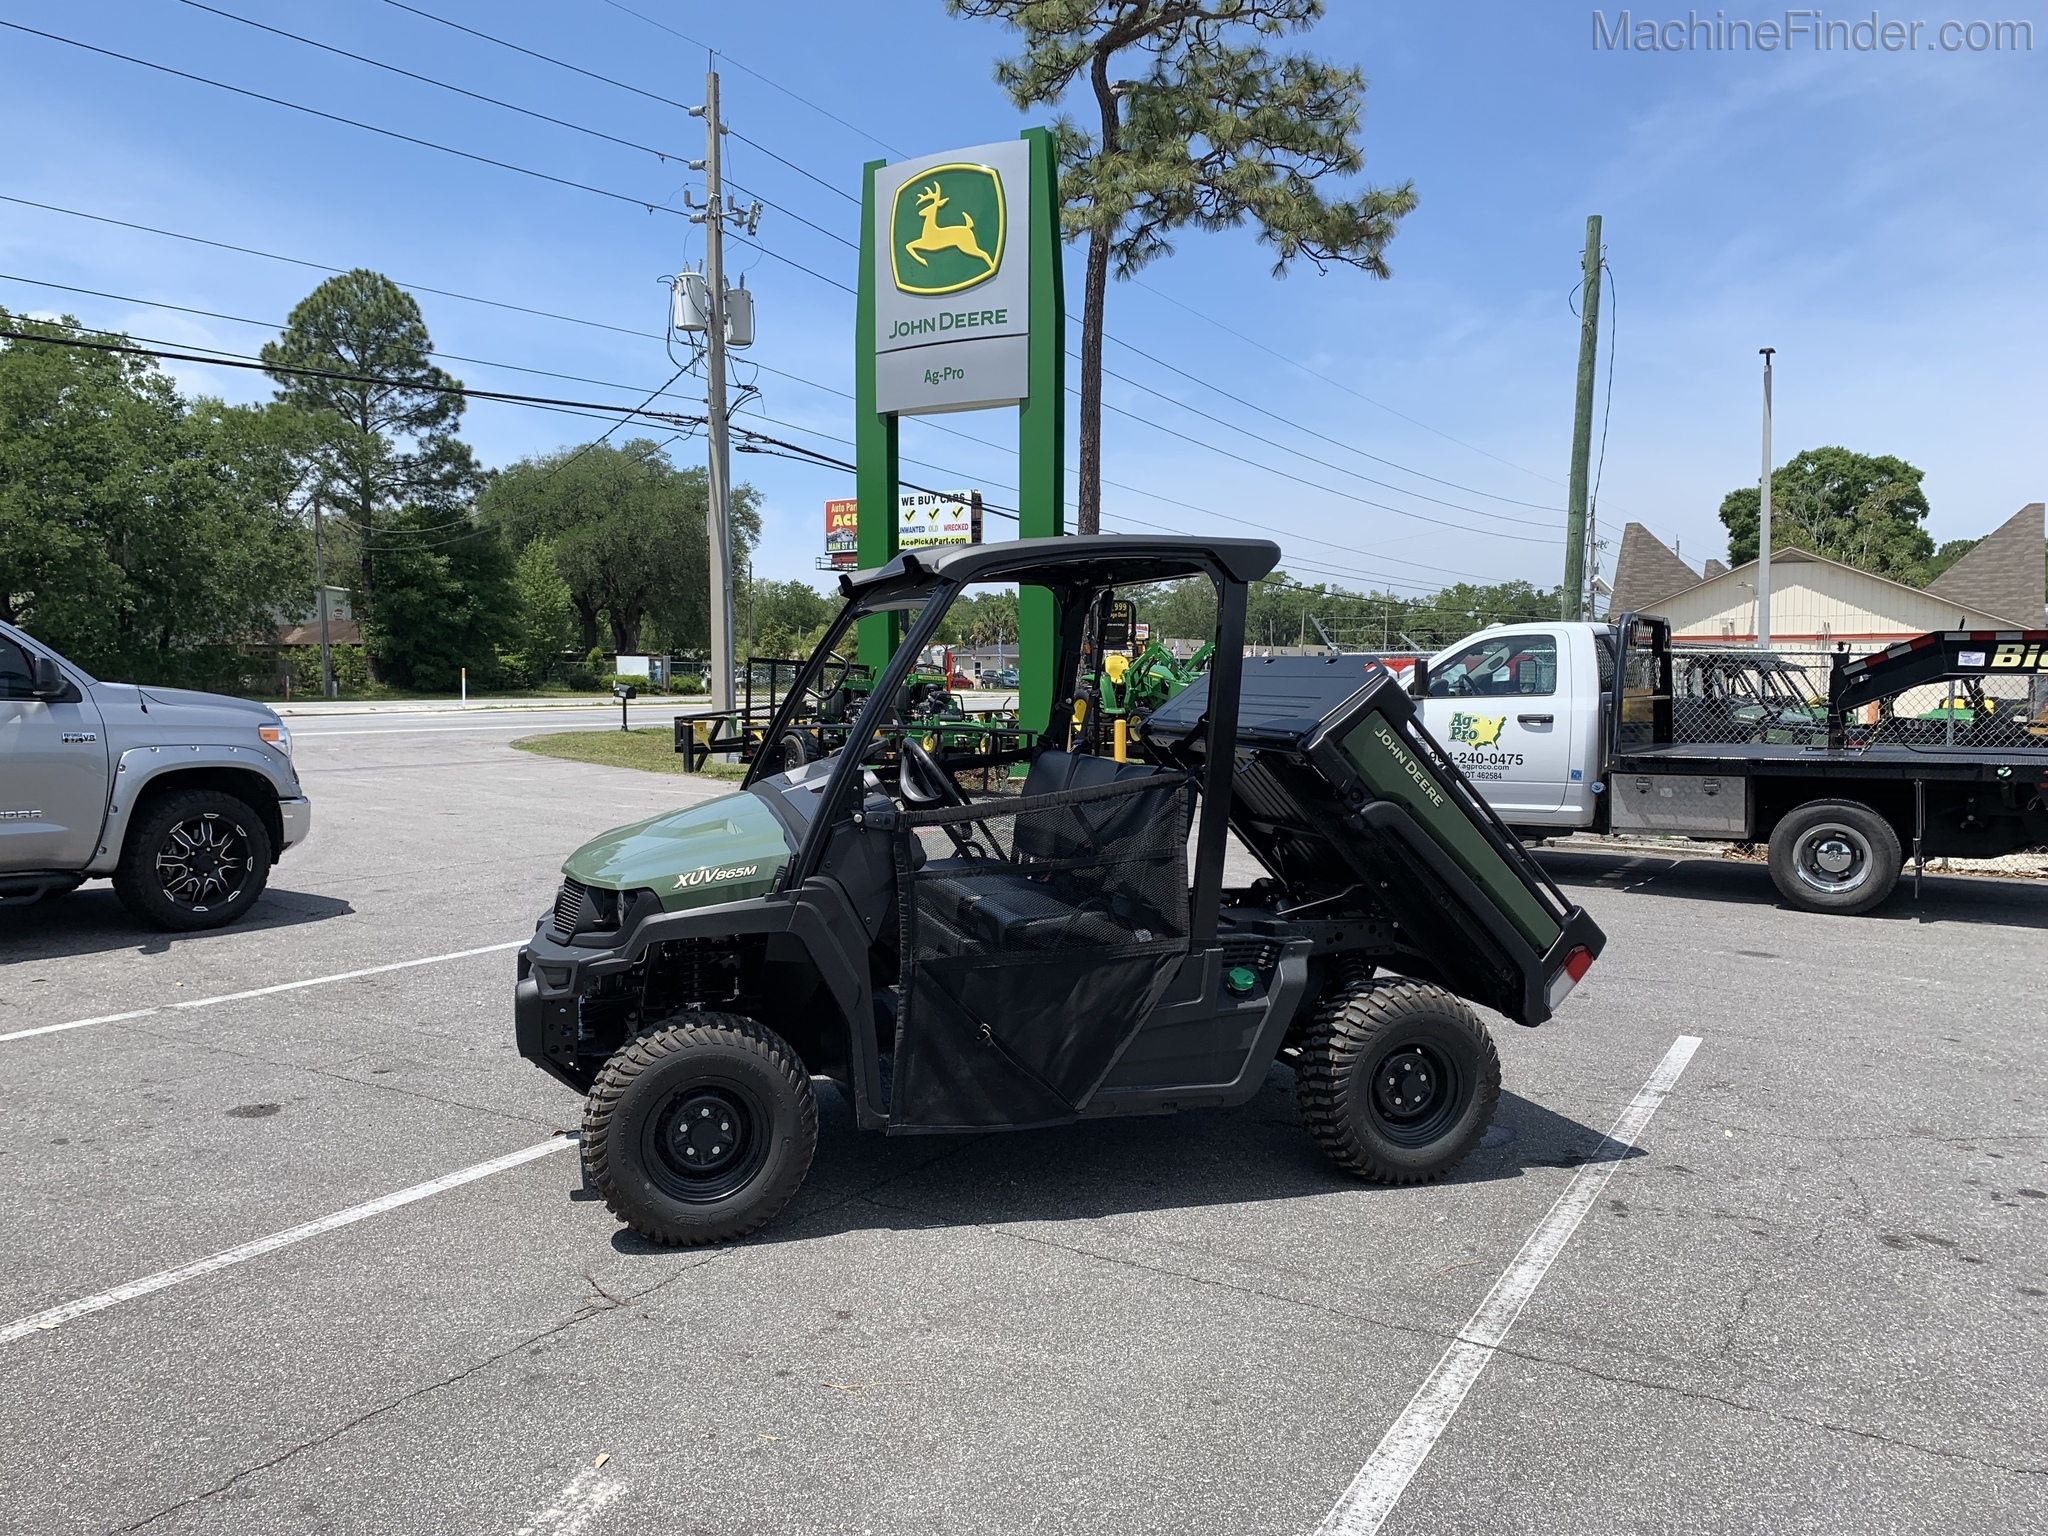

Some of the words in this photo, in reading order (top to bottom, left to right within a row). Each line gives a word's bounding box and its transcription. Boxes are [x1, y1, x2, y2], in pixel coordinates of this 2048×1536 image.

[888, 317, 936, 339] JOHN
[939, 309, 1007, 331] DEERE
[924, 366, 964, 385] Ag-Pro
[901, 496, 915, 506] WE
[918, 495, 937, 505] BUY
[940, 493, 965, 504] CARS
[831, 503, 845, 513] Auto
[928, 525, 939, 533] OLD
[944, 523, 969, 532] WRECKED
[828, 542, 841, 550] MAIN
[901, 537, 967, 546] AcePickAPart.com
[1450, 727, 1478, 740] Pro
[1374, 728, 1408, 765] JOHN
[1404, 760, 1444, 808] DEERE
[1455, 763, 1510, 771] .agproco.com
[1477, 771, 1502, 780] 462584
[672, 865, 758, 890] XUV865M
